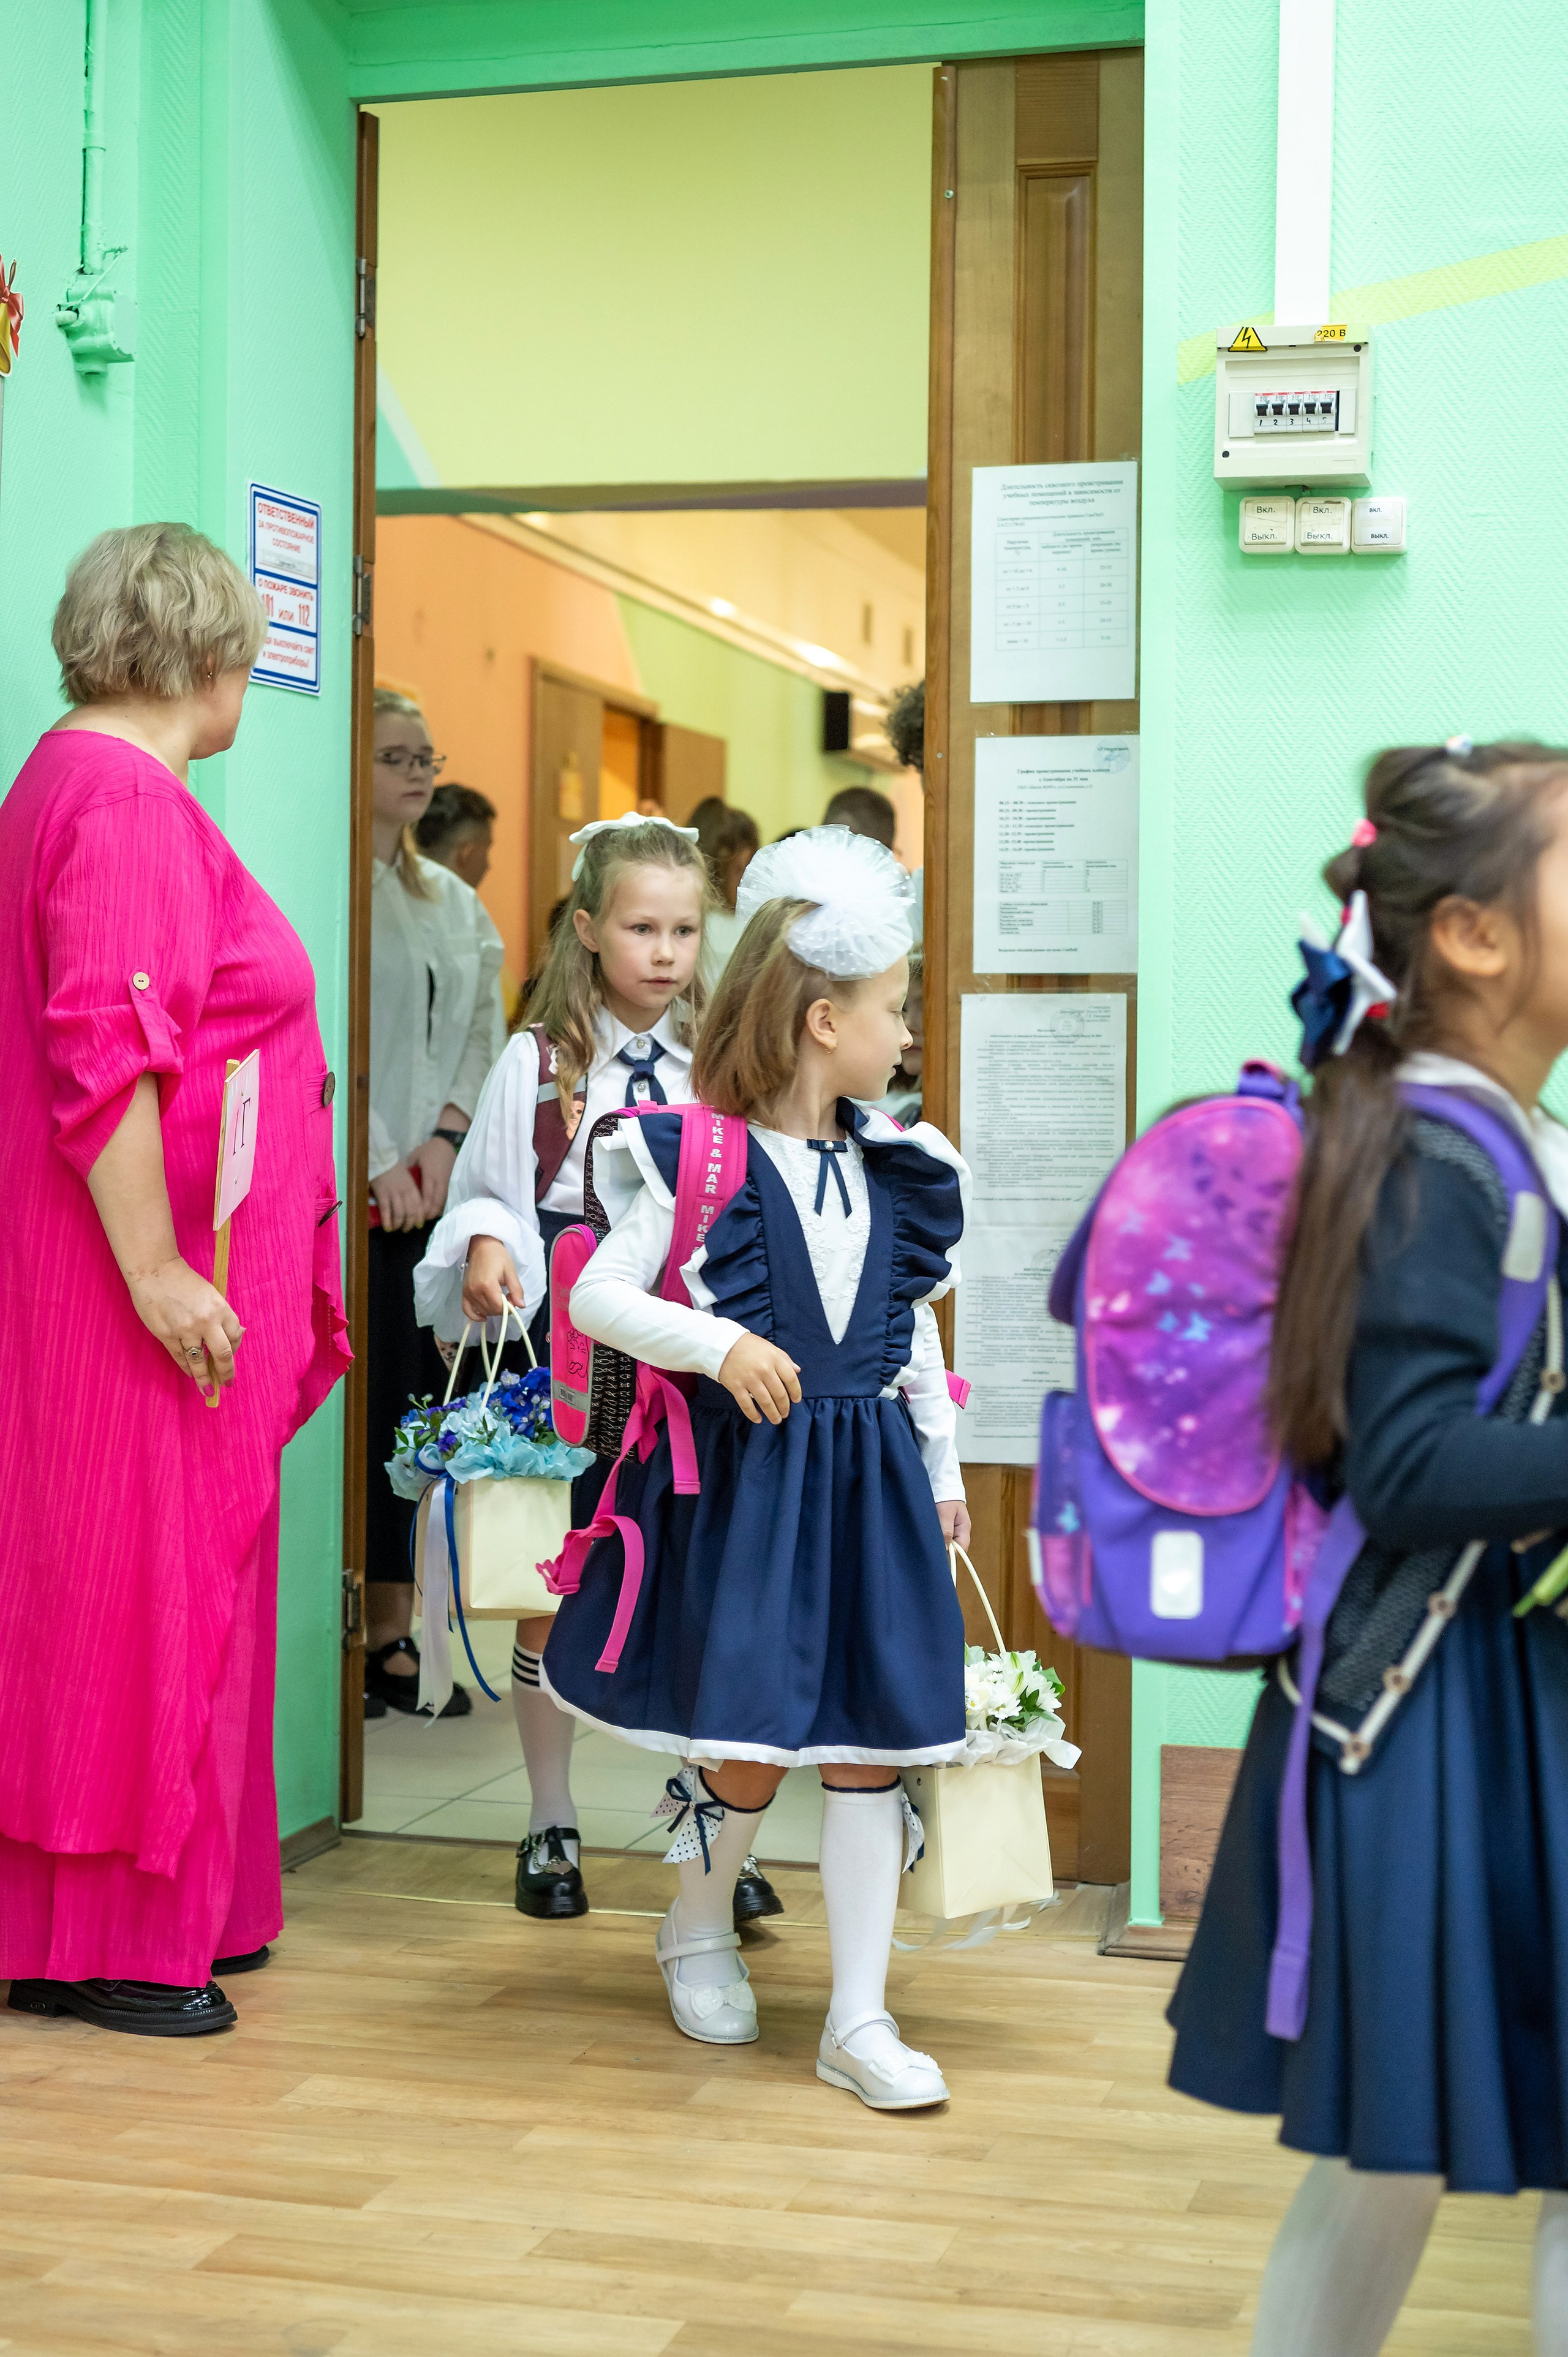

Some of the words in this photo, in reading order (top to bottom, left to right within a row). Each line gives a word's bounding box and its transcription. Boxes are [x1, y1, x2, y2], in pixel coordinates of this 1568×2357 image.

[258, 502, 314, 529] ОТВЕТСТВЕННЫЙ
[258, 578, 263, 587] О
[264, 579, 287, 594] ПОЖАРЕ
[289, 586, 314, 601] ЗВОНИТЬ
[279, 608, 294, 622] ИЛИ
[298, 603, 310, 627] 112
[710, 1112, 725, 1144] MIKE
[710, 1148, 722, 1158] &
[705, 1163, 722, 1194] MAR
[696, 1205, 715, 1242] MIKE
